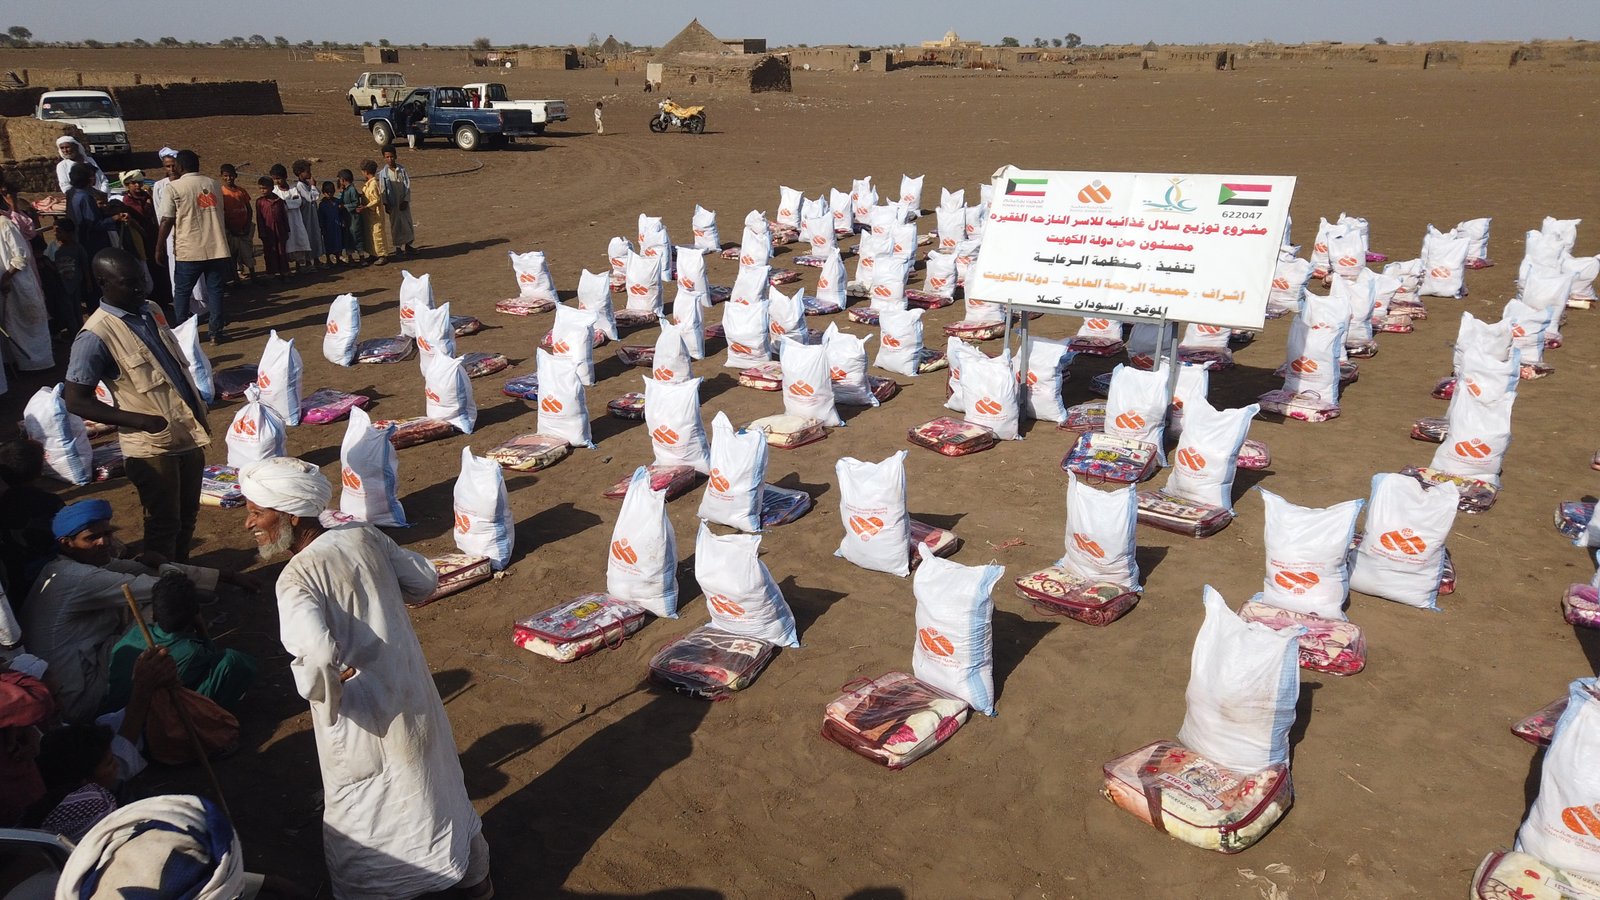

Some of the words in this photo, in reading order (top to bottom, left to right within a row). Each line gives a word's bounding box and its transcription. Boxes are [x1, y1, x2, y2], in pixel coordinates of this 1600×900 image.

[990, 212, 1029, 223] الفقيره
[1030, 214, 1070, 226] النازحه
[1071, 216, 1104, 227] للاسر
[1221, 210, 1263, 220] 622047
[1105, 216, 1145, 229] غذائيه
[1147, 219, 1180, 231] سلال
[1182, 222, 1220, 235] توزيع
[1222, 223, 1268, 237] مشروع
[1046, 234, 1088, 246] الكويت
[1089, 234, 1114, 248] دولة
[1116, 237, 1136, 248] من
[1139, 239, 1194, 252] محسنون
[1033, 251, 1090, 267] الرعاية
[1091, 254, 1142, 270] منظمة
[1155, 260, 1196, 275] تنفيذ
[982, 271, 1024, 283] الكويت
[1024, 272, 1049, 286] دولة
[1062, 276, 1103, 289] العالمية
[1103, 278, 1146, 294] الرحمة
[1148, 283, 1189, 298] جمعية
[1036, 294, 1063, 305] كسلا
[1201, 288, 1246, 304] إشراف
[1074, 299, 1124, 312] السودان
[1133, 304, 1169, 317] الموقع
[1166, 775, 1192, 790] TIGER
